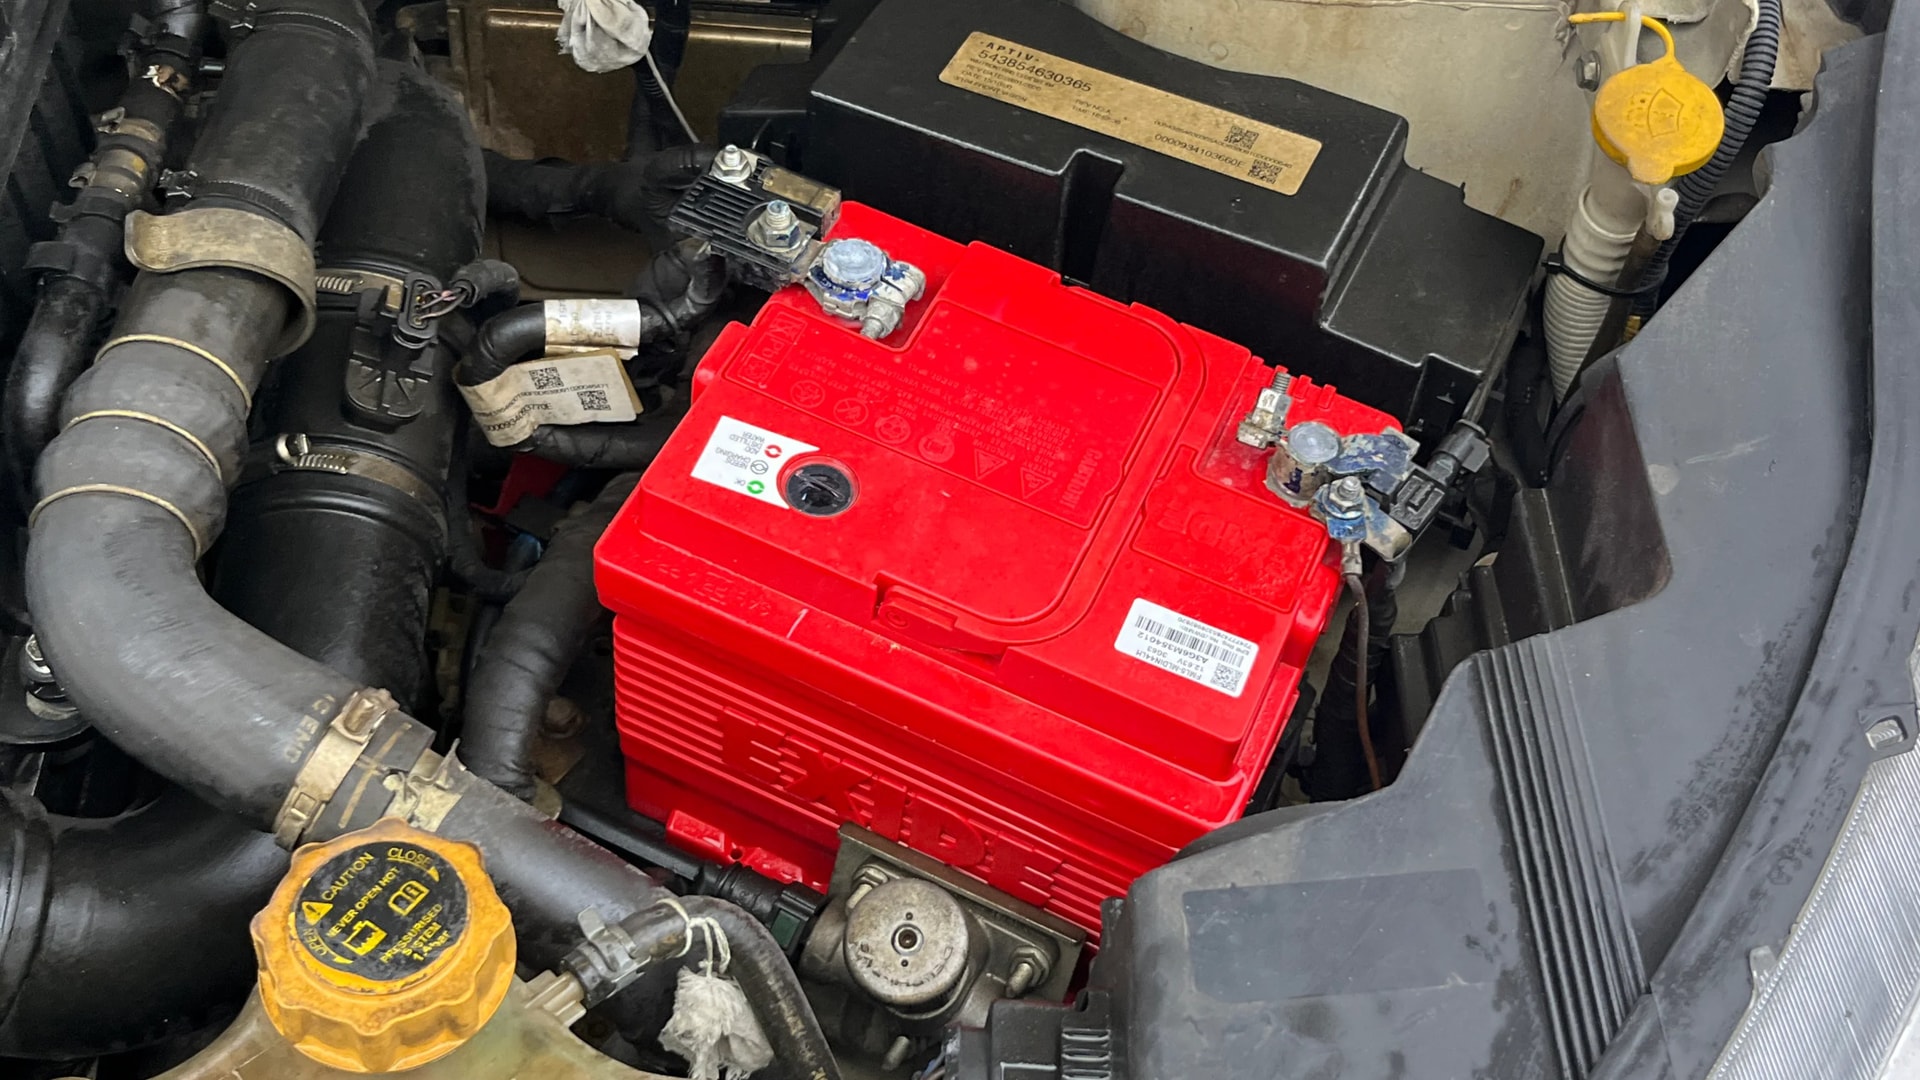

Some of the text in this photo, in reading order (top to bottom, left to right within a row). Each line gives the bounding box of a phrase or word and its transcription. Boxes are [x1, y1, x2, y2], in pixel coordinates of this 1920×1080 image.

[976, 48, 1094, 92] 543854630365
[984, 41, 1035, 61] APTIV
[1135, 630, 1210, 664] A3G6M354012
[719, 706, 1064, 906] EXIDE
[321, 852, 374, 902] CAUTION
[387, 847, 434, 868] CLOSE
[326, 866, 401, 938] NEVER OPEN HOT
[379, 903, 444, 965] PRESSURISED
[402, 922, 442, 957] SSTEM
